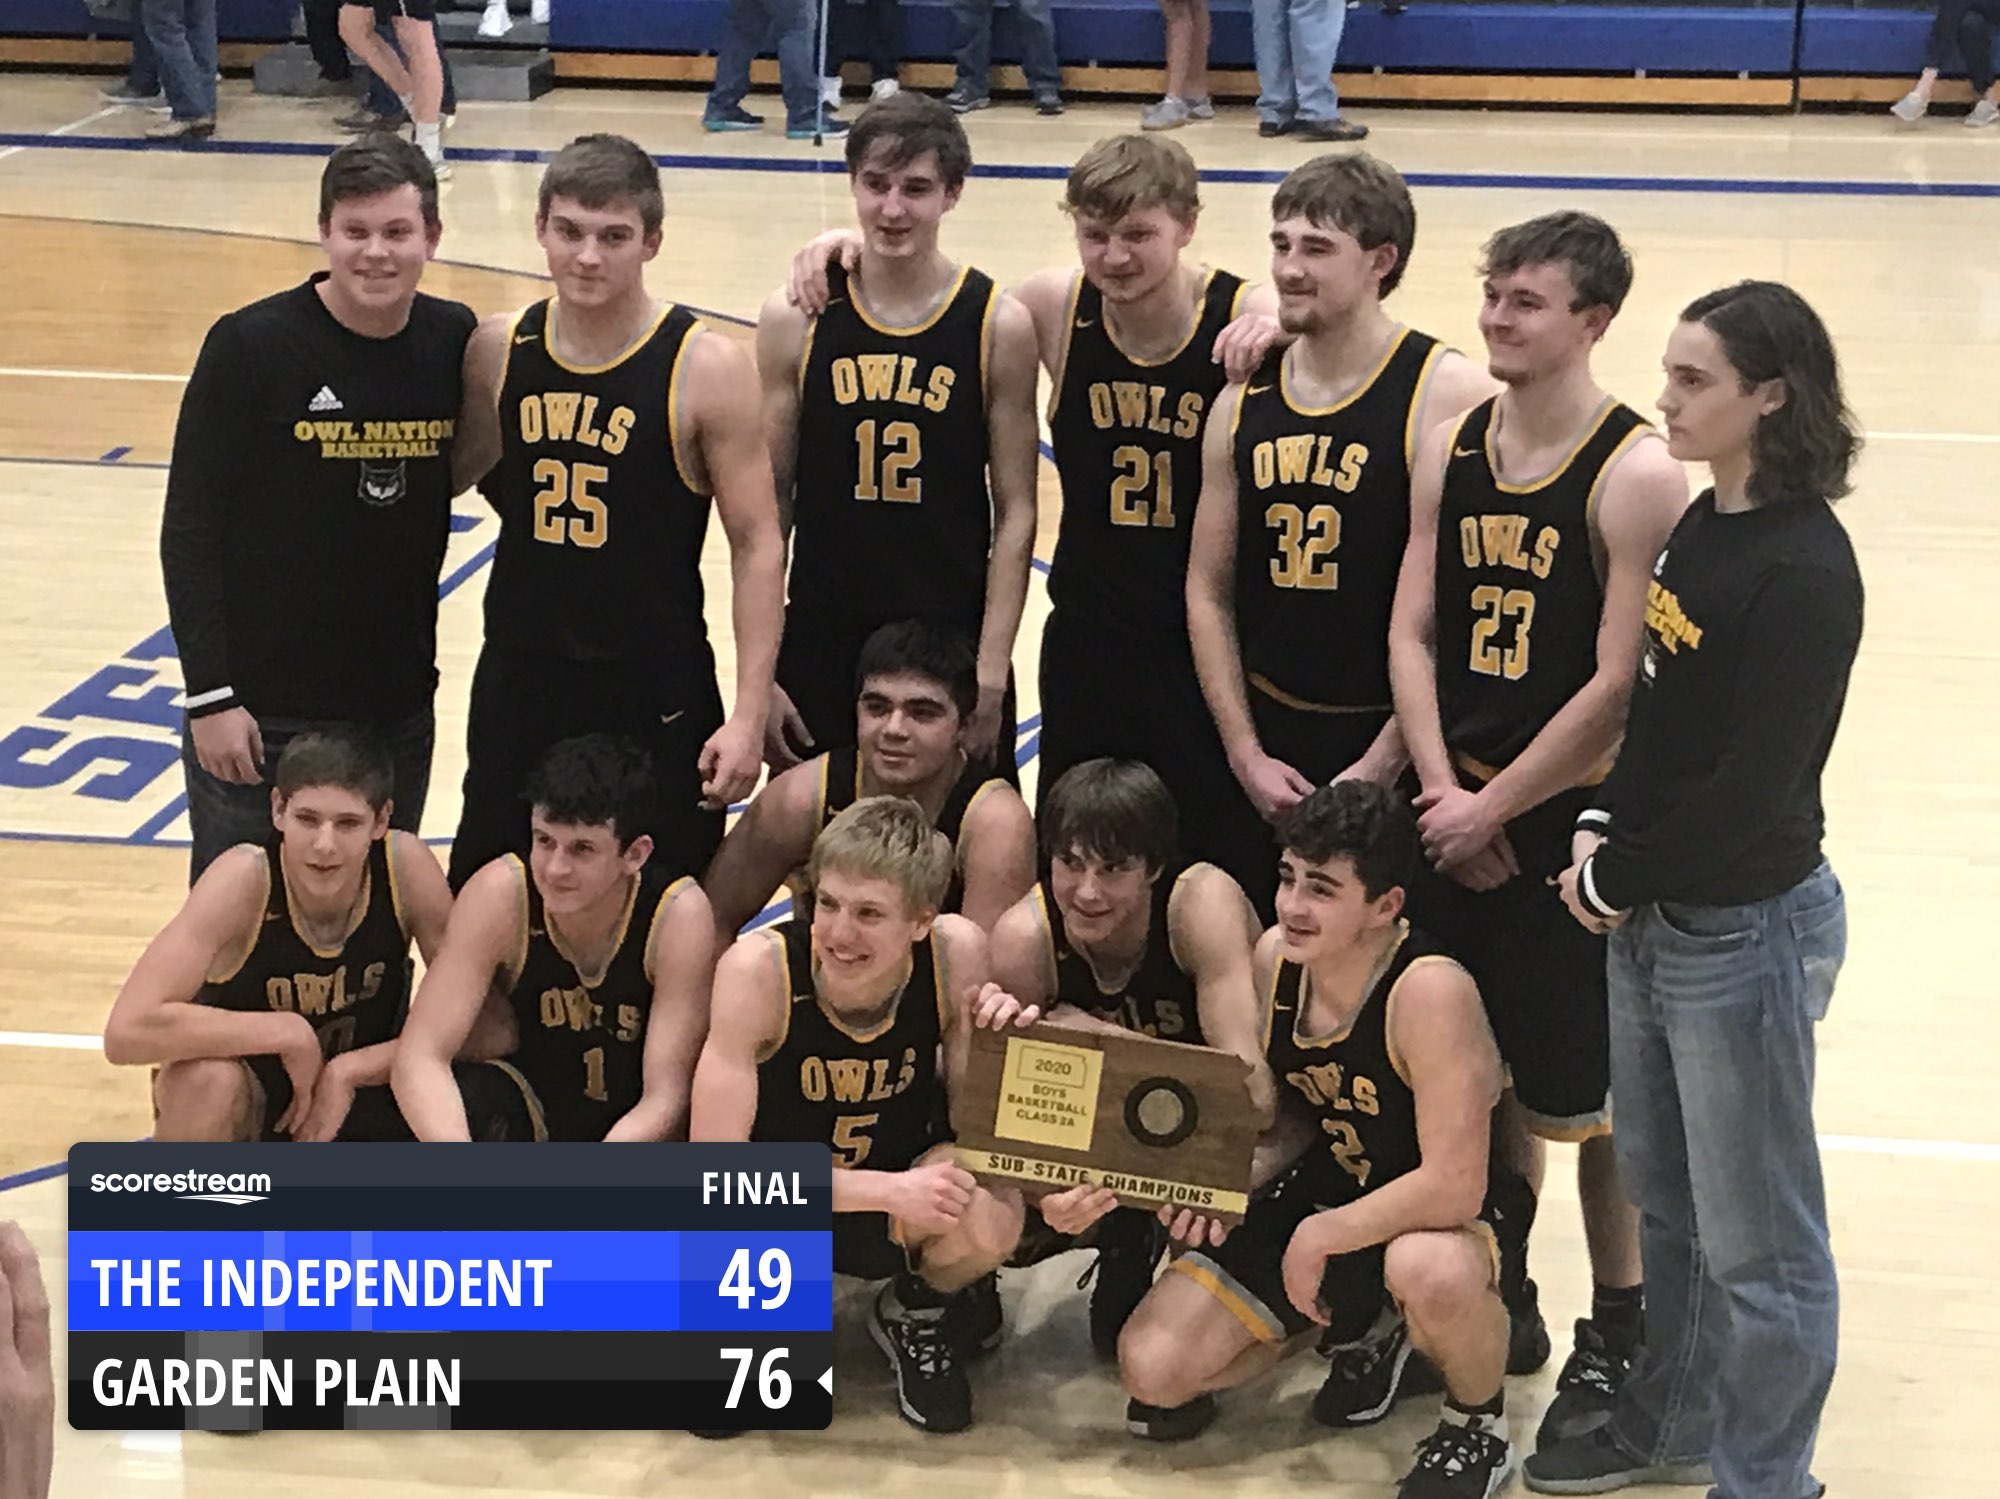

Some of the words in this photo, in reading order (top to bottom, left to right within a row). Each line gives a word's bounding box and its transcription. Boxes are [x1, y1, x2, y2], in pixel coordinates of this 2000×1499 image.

[831, 354, 956, 412] OWLS
[1089, 381, 1203, 438] OWLS
[294, 420, 359, 441] OWL
[363, 419, 455, 440] NATION
[321, 441, 439, 458] BASKETBALL
[520, 392, 636, 455] OWLS
[855, 419, 922, 503] 12
[1110, 445, 1175, 528] 21
[1253, 434, 1369, 493] OWLS
[533, 458, 608, 548] 25
[1265, 503, 1341, 589] 32
[1460, 514, 1560, 579] OWLS
[1469, 585, 1535, 680] 23
[583, 1046, 608, 1101] 1
[801, 1048, 916, 1102] OWLS
[1032, 1084, 1066, 1098] BOYS
[1035, 1058, 1071, 1075] 2020
[1007, 1093, 1087, 1116] BASKETBALL
[1016, 1109, 1057, 1124] CLASS
[832, 1113, 879, 1170] 5
[1322, 1118, 1371, 1187] 2
[1102, 1174, 1213, 1205] CHAMPIONS
